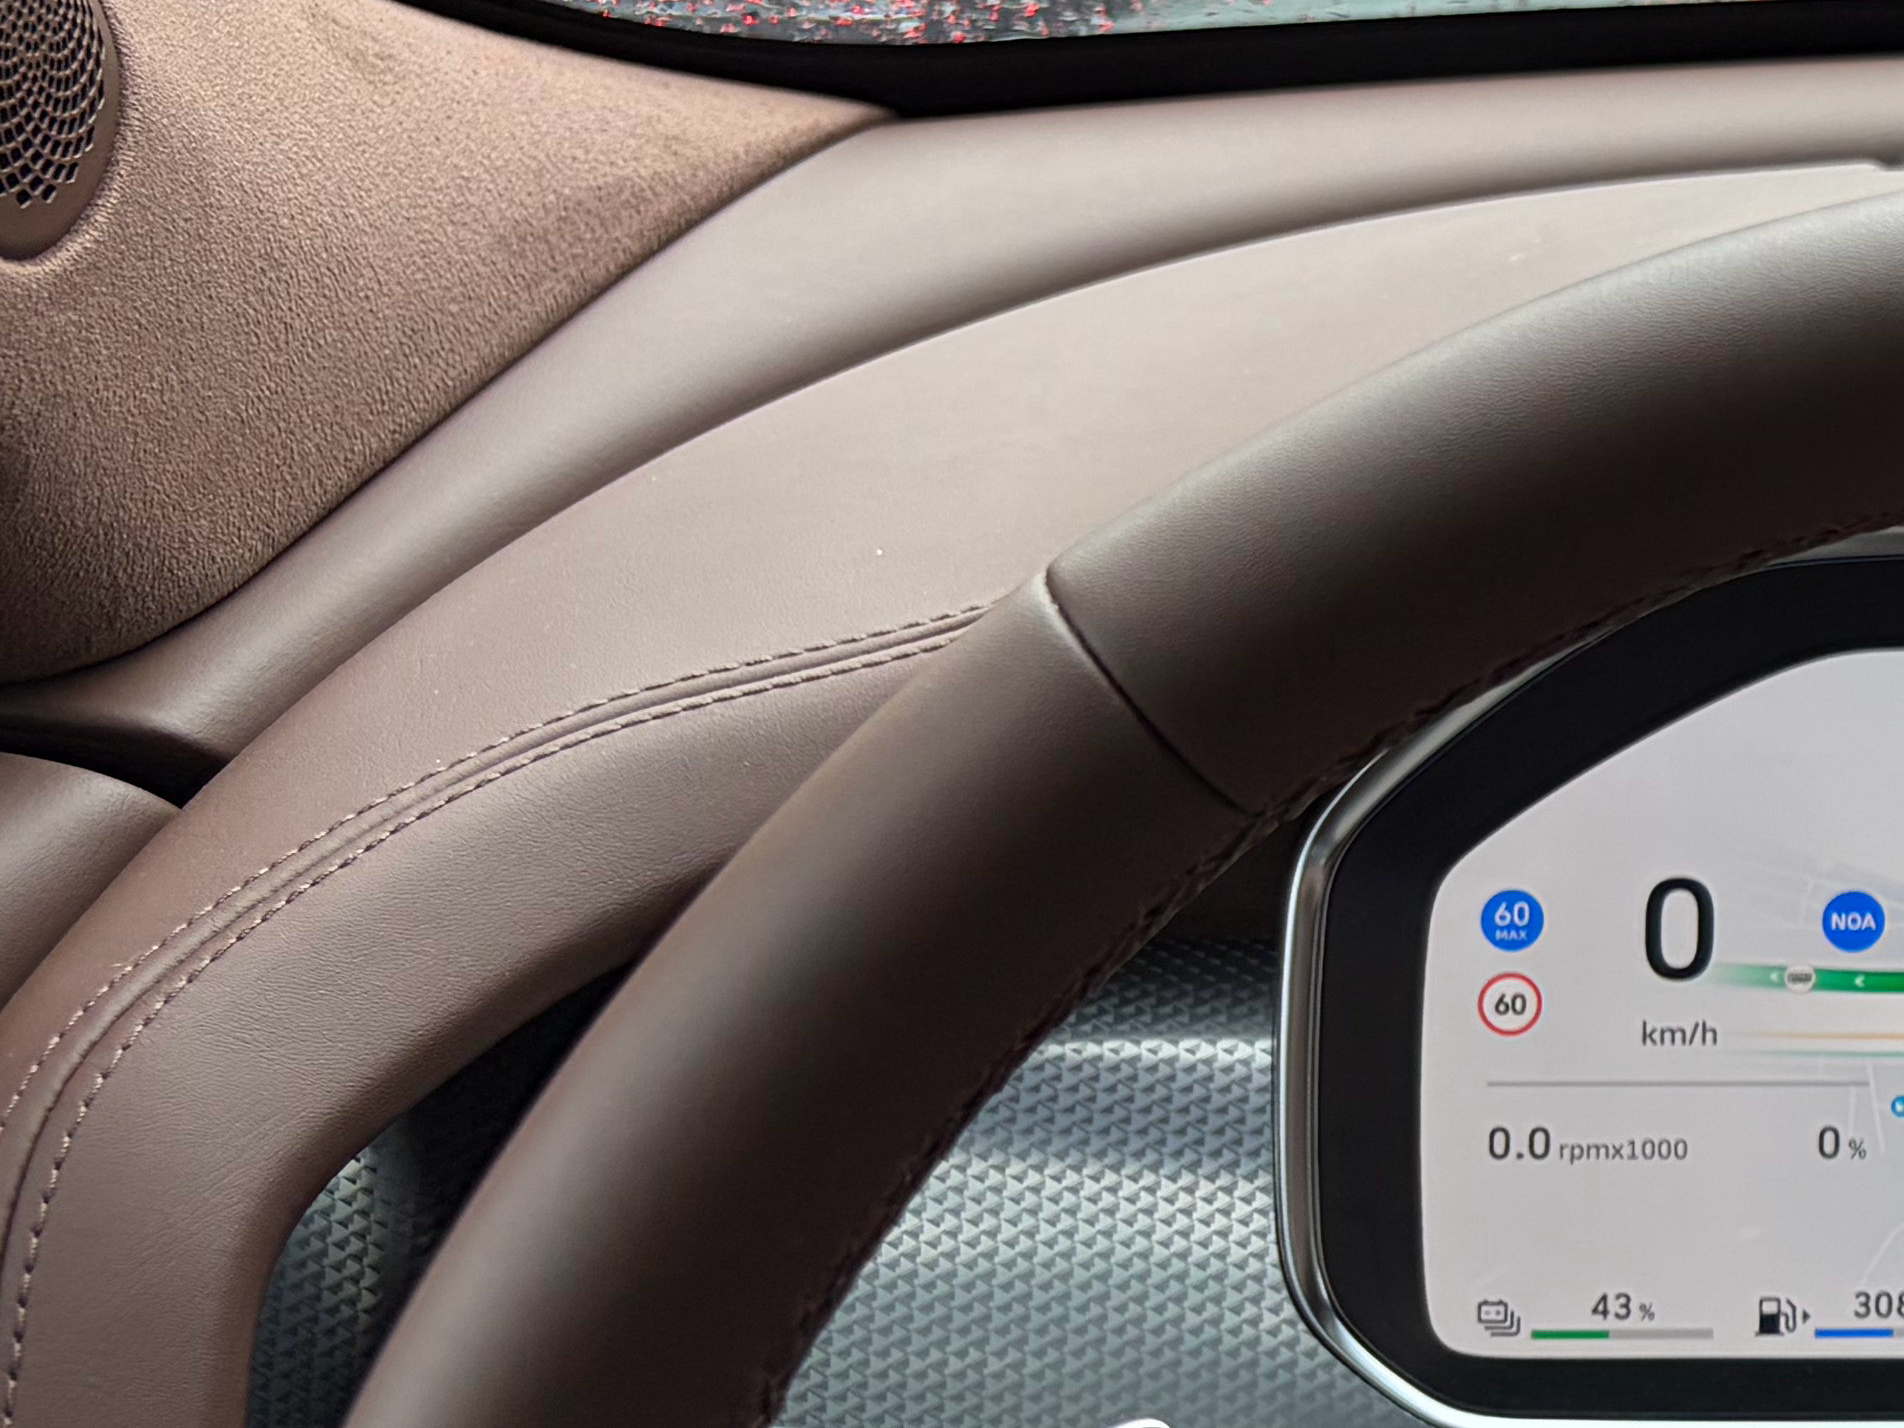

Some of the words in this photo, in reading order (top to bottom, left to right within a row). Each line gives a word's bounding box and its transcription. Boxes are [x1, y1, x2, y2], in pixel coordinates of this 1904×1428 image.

[1494, 902, 1531, 928] 60
[1830, 912, 1877, 932] NOA
[1495, 929, 1529, 942] MAX
[1643, 876, 1716, 982] 0
[1494, 992, 1528, 1017] 60
[1640, 1019, 1719, 1050] km/h
[1486, 1124, 1551, 1162] 0.0
[1557, 1137, 1689, 1166] rpmx1000
